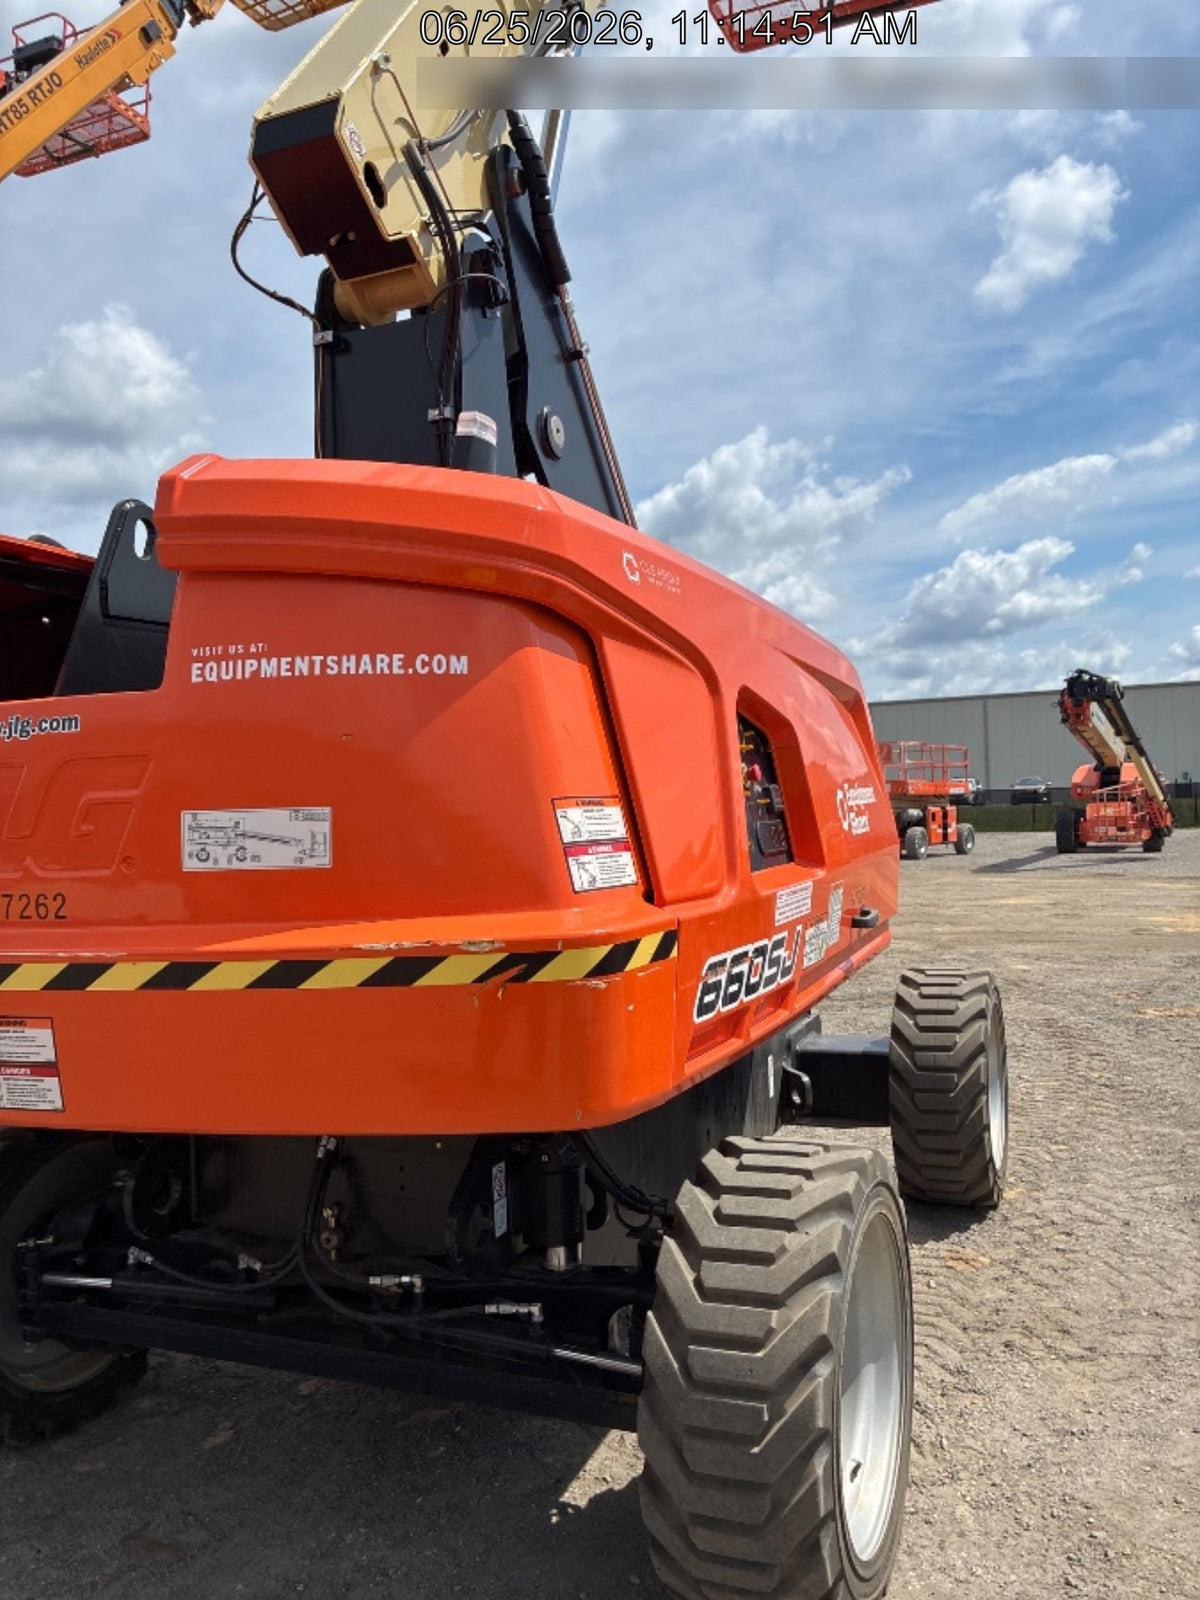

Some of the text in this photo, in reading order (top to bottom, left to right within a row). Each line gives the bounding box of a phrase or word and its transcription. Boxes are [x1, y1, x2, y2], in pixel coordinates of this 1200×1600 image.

[192, 643, 268, 657] VISIT US AT:
[191, 653, 469, 683] EQUIPMENTSHARE.COM
[1, 893, 67, 920] 7262
[694, 925, 802, 1022] 660SJ
